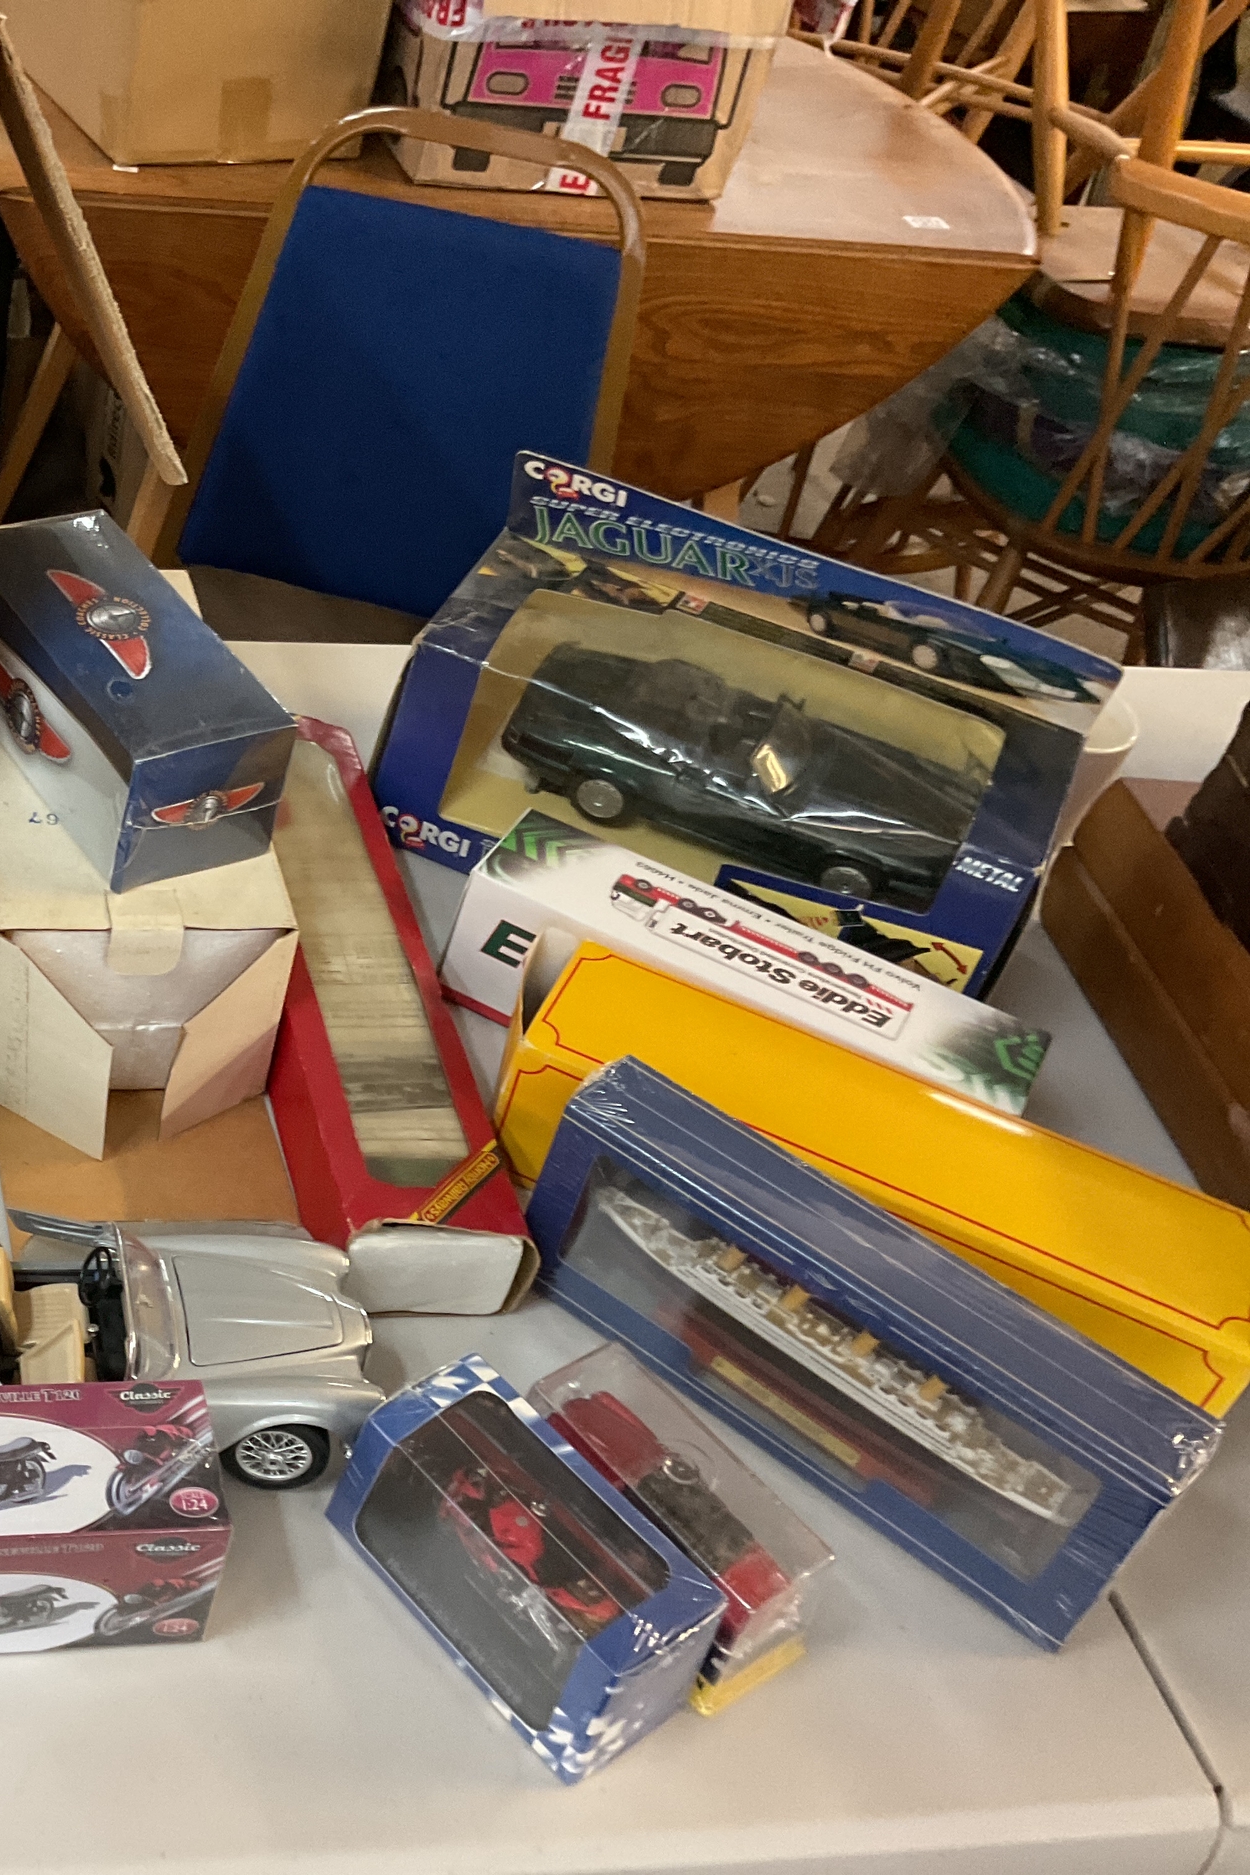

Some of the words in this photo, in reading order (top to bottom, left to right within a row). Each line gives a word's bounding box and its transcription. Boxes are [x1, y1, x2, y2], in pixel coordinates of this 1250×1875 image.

[582, 37, 634, 120] FRAGI
[523, 461, 628, 508] CORGI
[533, 505, 755, 586] JAGUAR
[748, 556, 819, 589] XJS
[381, 805, 471, 858] CORGI
[955, 856, 1025, 893] METAL
[669, 922, 796, 986] Stobart
[798, 980, 892, 1028] Eddie
[429, 1180, 468, 1218] Railways
[120, 1389, 171, 1400] Classic
[135, 1542, 201, 1552] Classic
